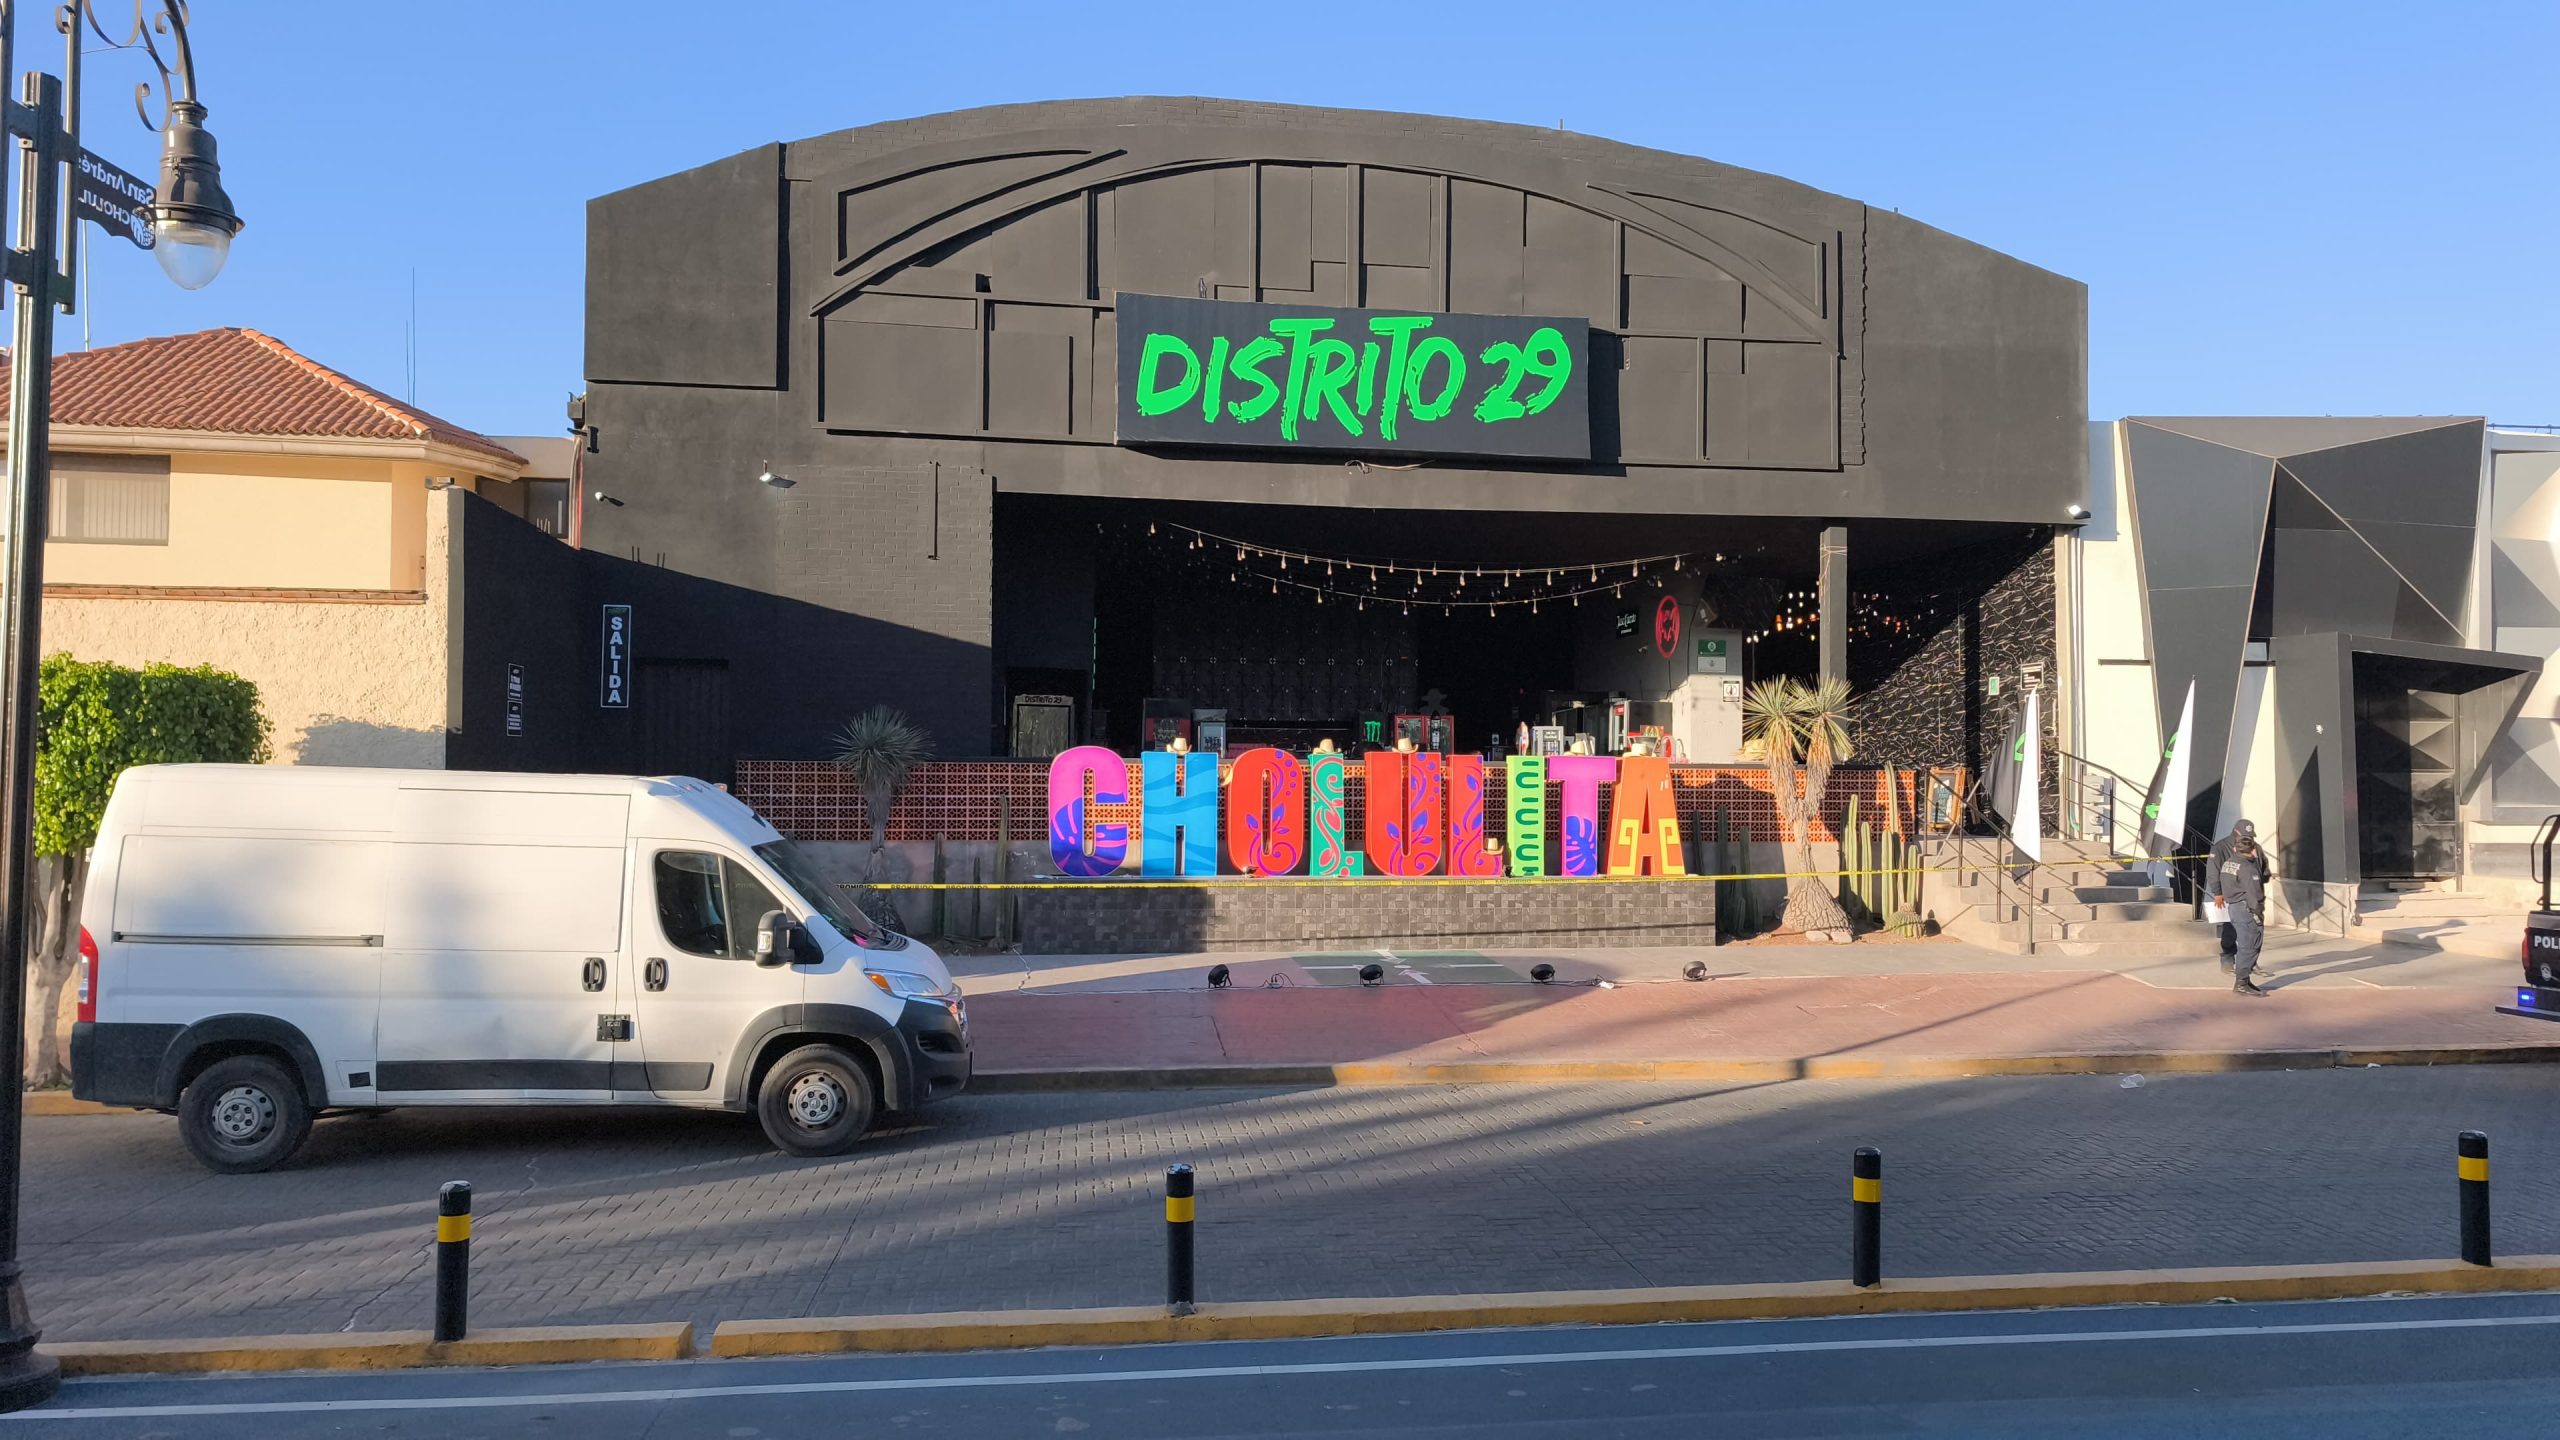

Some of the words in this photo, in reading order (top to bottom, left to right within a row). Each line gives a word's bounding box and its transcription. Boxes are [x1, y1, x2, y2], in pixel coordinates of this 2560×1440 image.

[1136, 316, 1467, 441] DISTRITO
[1473, 327, 1573, 423] 29
[608, 616, 622, 704] SALIDA
[1048, 745, 1686, 877] CHOLULITA
[2534, 935, 2560, 949] POLI
